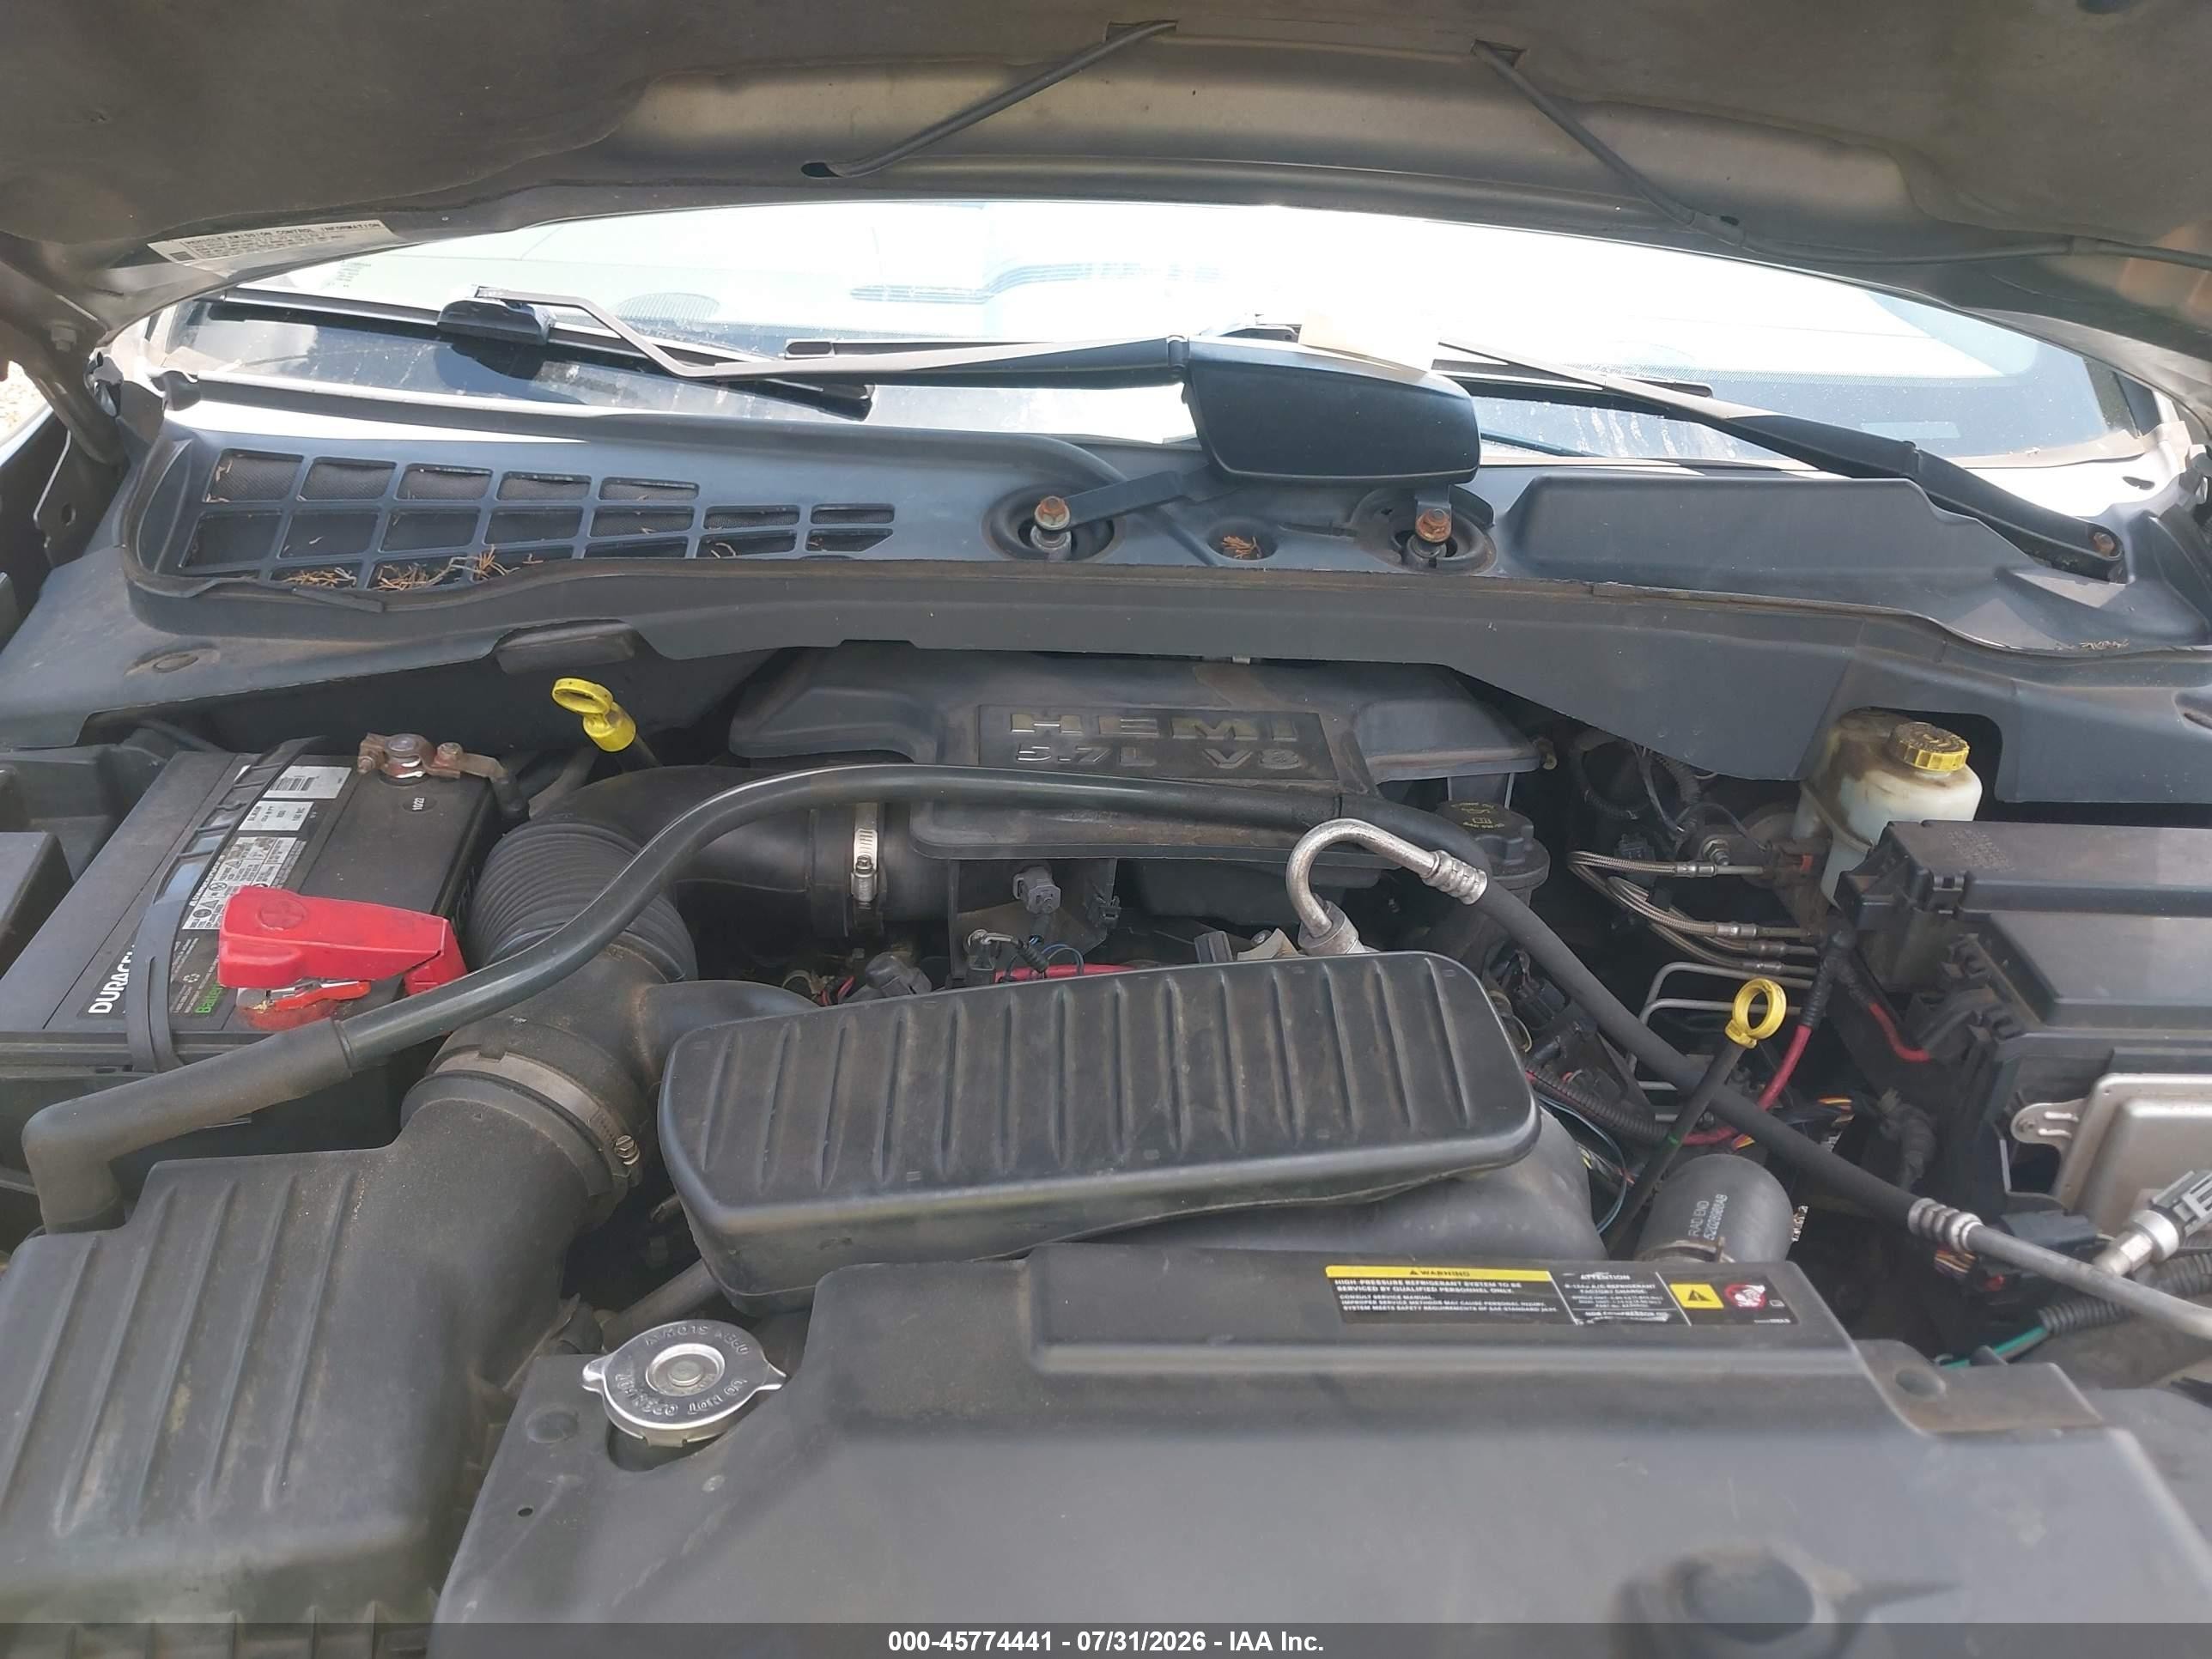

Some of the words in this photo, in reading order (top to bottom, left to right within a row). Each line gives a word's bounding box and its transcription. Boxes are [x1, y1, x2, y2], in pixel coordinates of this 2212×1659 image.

[228, 231, 272, 240] EMISSION
[322, 223, 380, 232] INFORMATION
[1011, 713, 1297, 742] HEMI
[1016, 743, 1157, 767] 5.7L
[1202, 748, 1303, 769] V8
[88, 945, 134, 1013] DURAC
